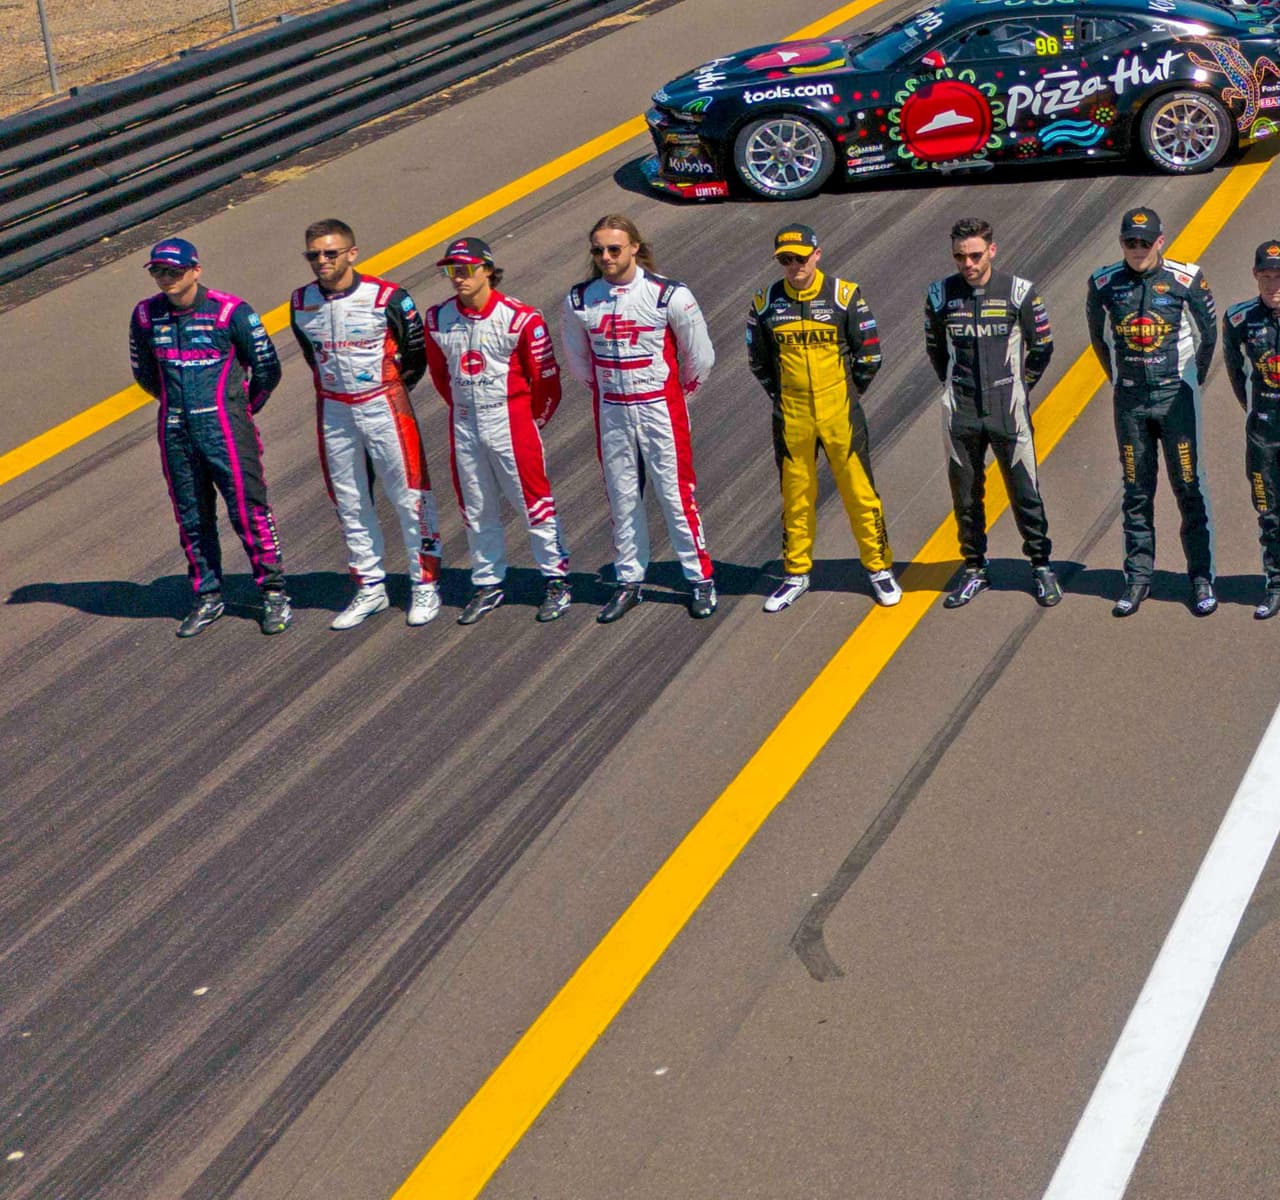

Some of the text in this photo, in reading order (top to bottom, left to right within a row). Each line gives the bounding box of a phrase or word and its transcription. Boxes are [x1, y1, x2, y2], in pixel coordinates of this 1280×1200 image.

[1035, 37, 1060, 56] 96
[743, 82, 834, 104] tools.com
[1006, 49, 1185, 127] Pizza Hut
[669, 157, 714, 175] Kubota
[590, 314, 655, 346] JET
[775, 330, 836, 345] DEWALT
[1116, 325, 1174, 337] PENRITE
[1123, 443, 1136, 484] PENRITE
[1177, 441, 1194, 483] PENRITE
[1252, 471, 1268, 512] PENRITE
